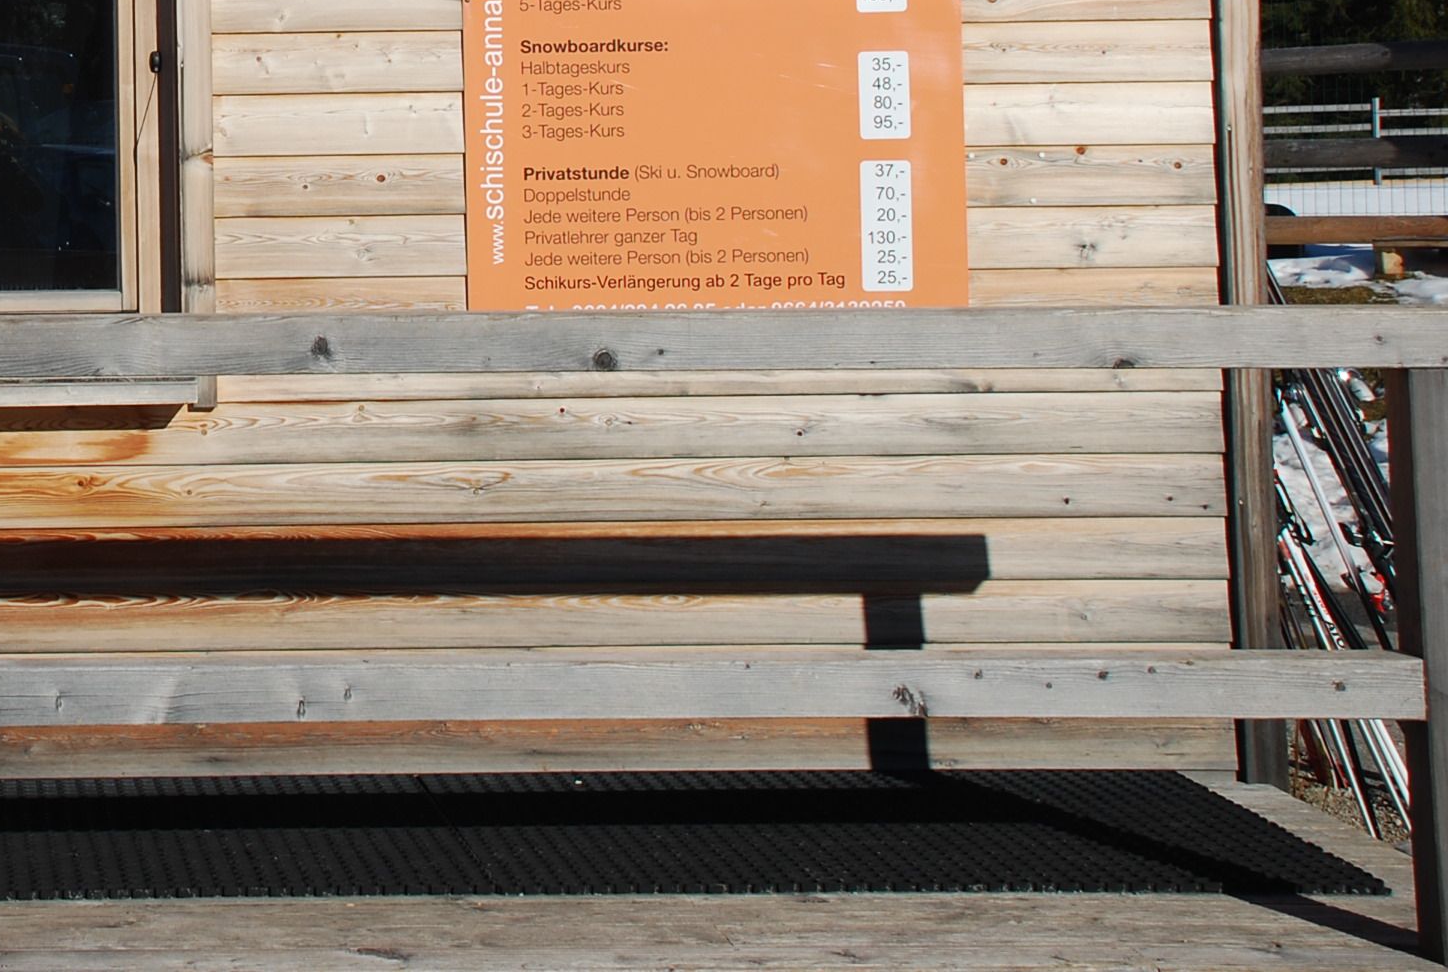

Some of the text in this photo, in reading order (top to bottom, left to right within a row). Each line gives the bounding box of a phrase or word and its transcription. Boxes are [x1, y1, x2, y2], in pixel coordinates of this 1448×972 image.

[520, 39, 668, 54] Snowboardkurse:
[521, 60, 630, 77] Halbtageskurs
[872, 57, 902, 72] 35,-
[523, 82, 623, 99] 1-Tages-Kurs
[872, 77, 902, 91] 48,-
[874, 95, 903, 110] 80,-
[522, 102, 624, 120] 2-Tages-Kurs
[874, 115, 903, 130] 95,-
[522, 124, 624, 141] 3-Tages-Kurs
[524, 164, 779, 182] Privatstunde (Ski u. Snowboard)
[875, 164, 904, 178] 37,-
[524, 188, 630, 204] Doppelstunde
[876, 187, 905, 201] 70,-
[523, 206, 807, 225] Jede weitere Person (bis 2 Personen)
[877, 208, 907, 223] 20,-
[525, 229, 697, 247] Privatlehrer ganzer Tag
[868, 230, 907, 244] 130,-
[524, 248, 808, 267] Jede weitere Person (bis 2 Personen)
[878, 250, 907, 264] 25,-
[525, 272, 845, 292] Schikurs-Verlängerung ab 2 Tage pro Tag
[878, 270, 907, 284] 25,-
